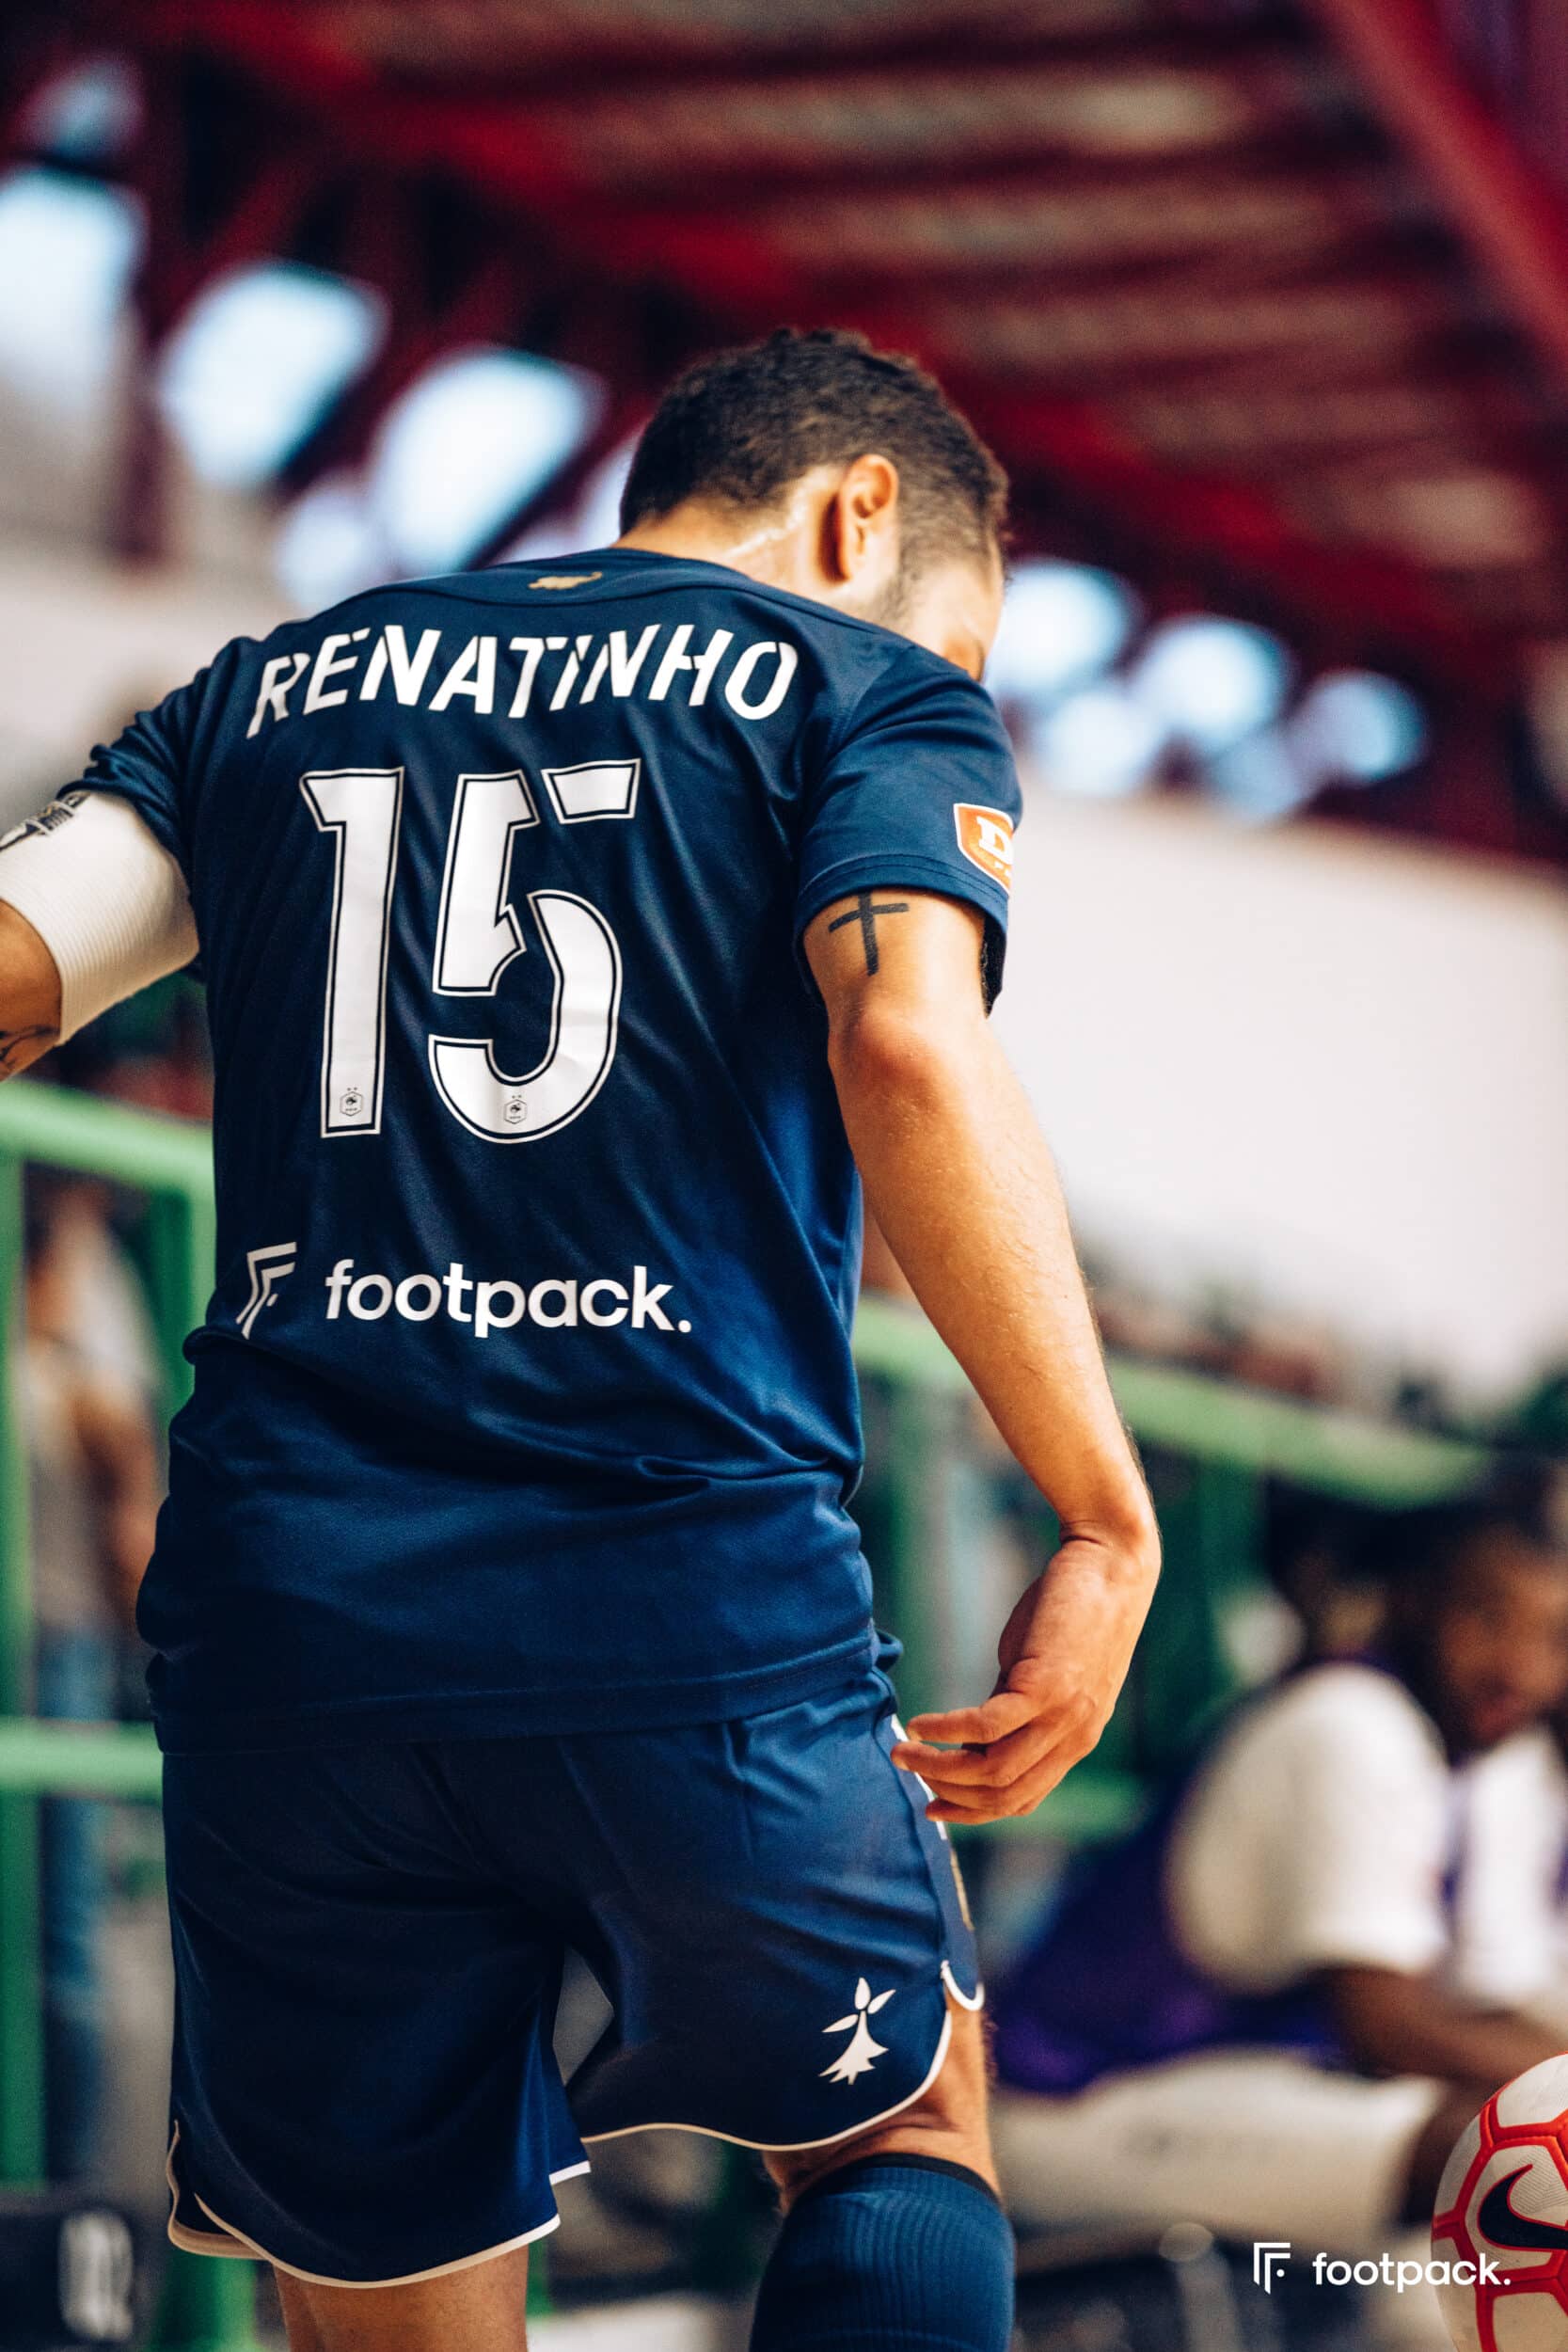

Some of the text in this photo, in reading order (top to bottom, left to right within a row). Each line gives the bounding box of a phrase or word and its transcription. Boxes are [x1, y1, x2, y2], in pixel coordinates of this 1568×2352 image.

[246, 624, 799, 739] RENATINHO
[299, 757, 641, 1144] 15
[325, 1258, 692, 1339] footpack.
